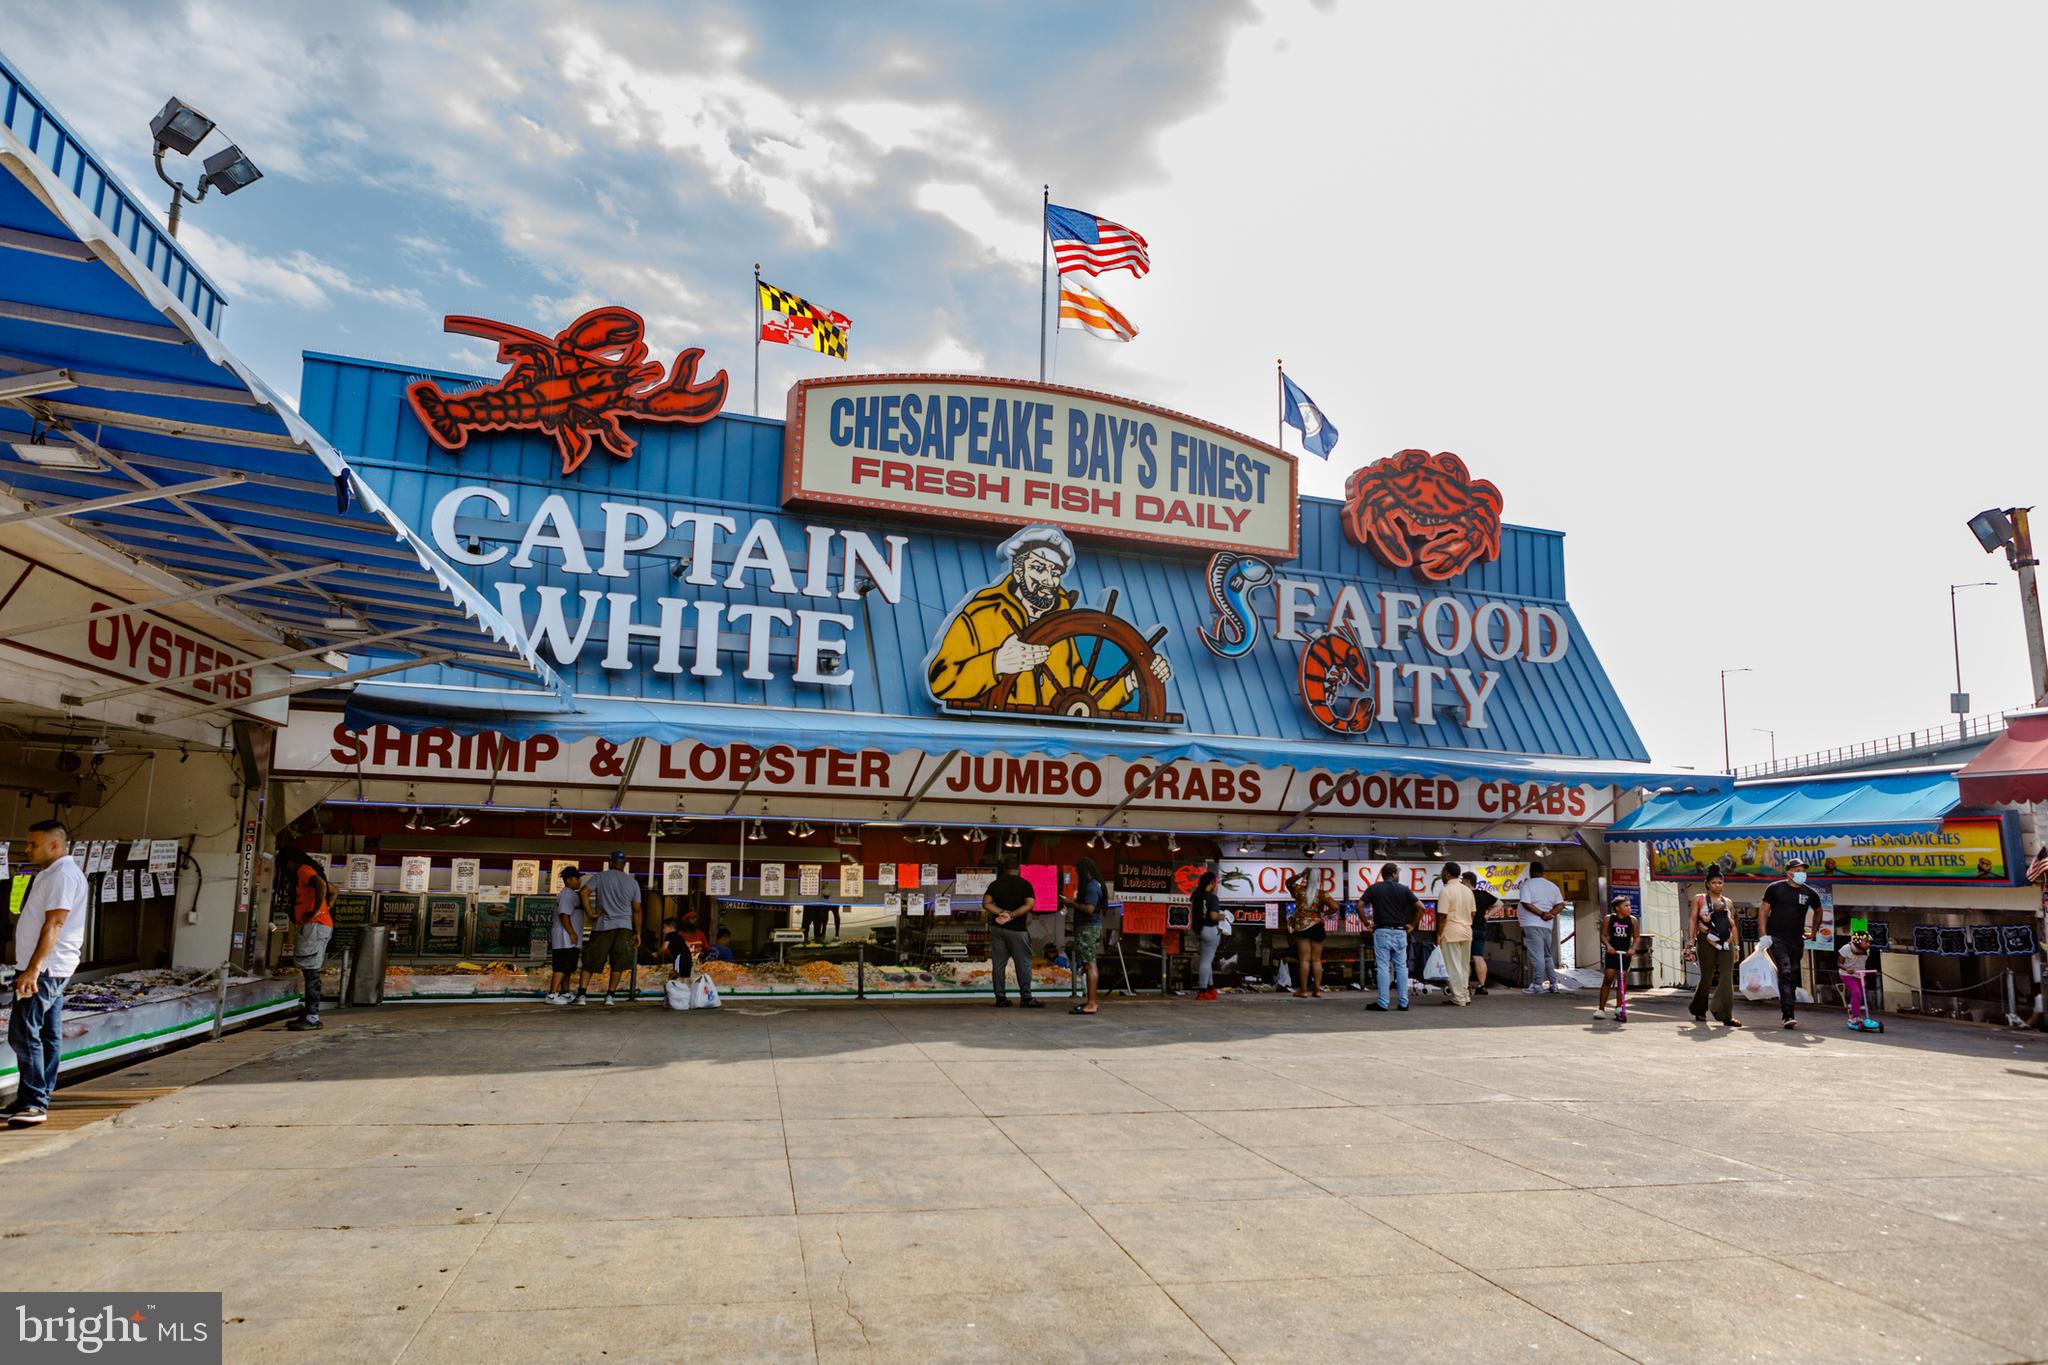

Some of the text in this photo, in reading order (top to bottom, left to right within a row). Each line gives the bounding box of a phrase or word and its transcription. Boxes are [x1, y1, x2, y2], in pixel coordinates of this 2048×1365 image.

[829, 394, 1271, 504] CHESAPEAKE BAY'S FINEST
[852, 456, 1251, 533] FRESH FISH DAILY
[431, 486, 909, 604] CAPTAIN
[88, 602, 253, 699] OYSTERS
[494, 581, 854, 686] WHITE
[330, 721, 891, 788] SHRIMP & LOBSTER
[946, 756, 1261, 804] JUMBO CRABS
[1309, 773, 1586, 817] COOKED CRABS
[1881, 832, 1961, 846] SANDWICHES
[1119, 864, 1139, 875] Live
[1667, 847, 1694, 868] BAR
[1773, 849, 1826, 868] SHRIMP
[1851, 854, 1967, 867] SEAFOOD PLATTERS
[1122, 877, 1167, 889] Lobsters
[1258, 866, 1428, 894] CRB SE
[383, 902, 415, 913] SHRIMP
